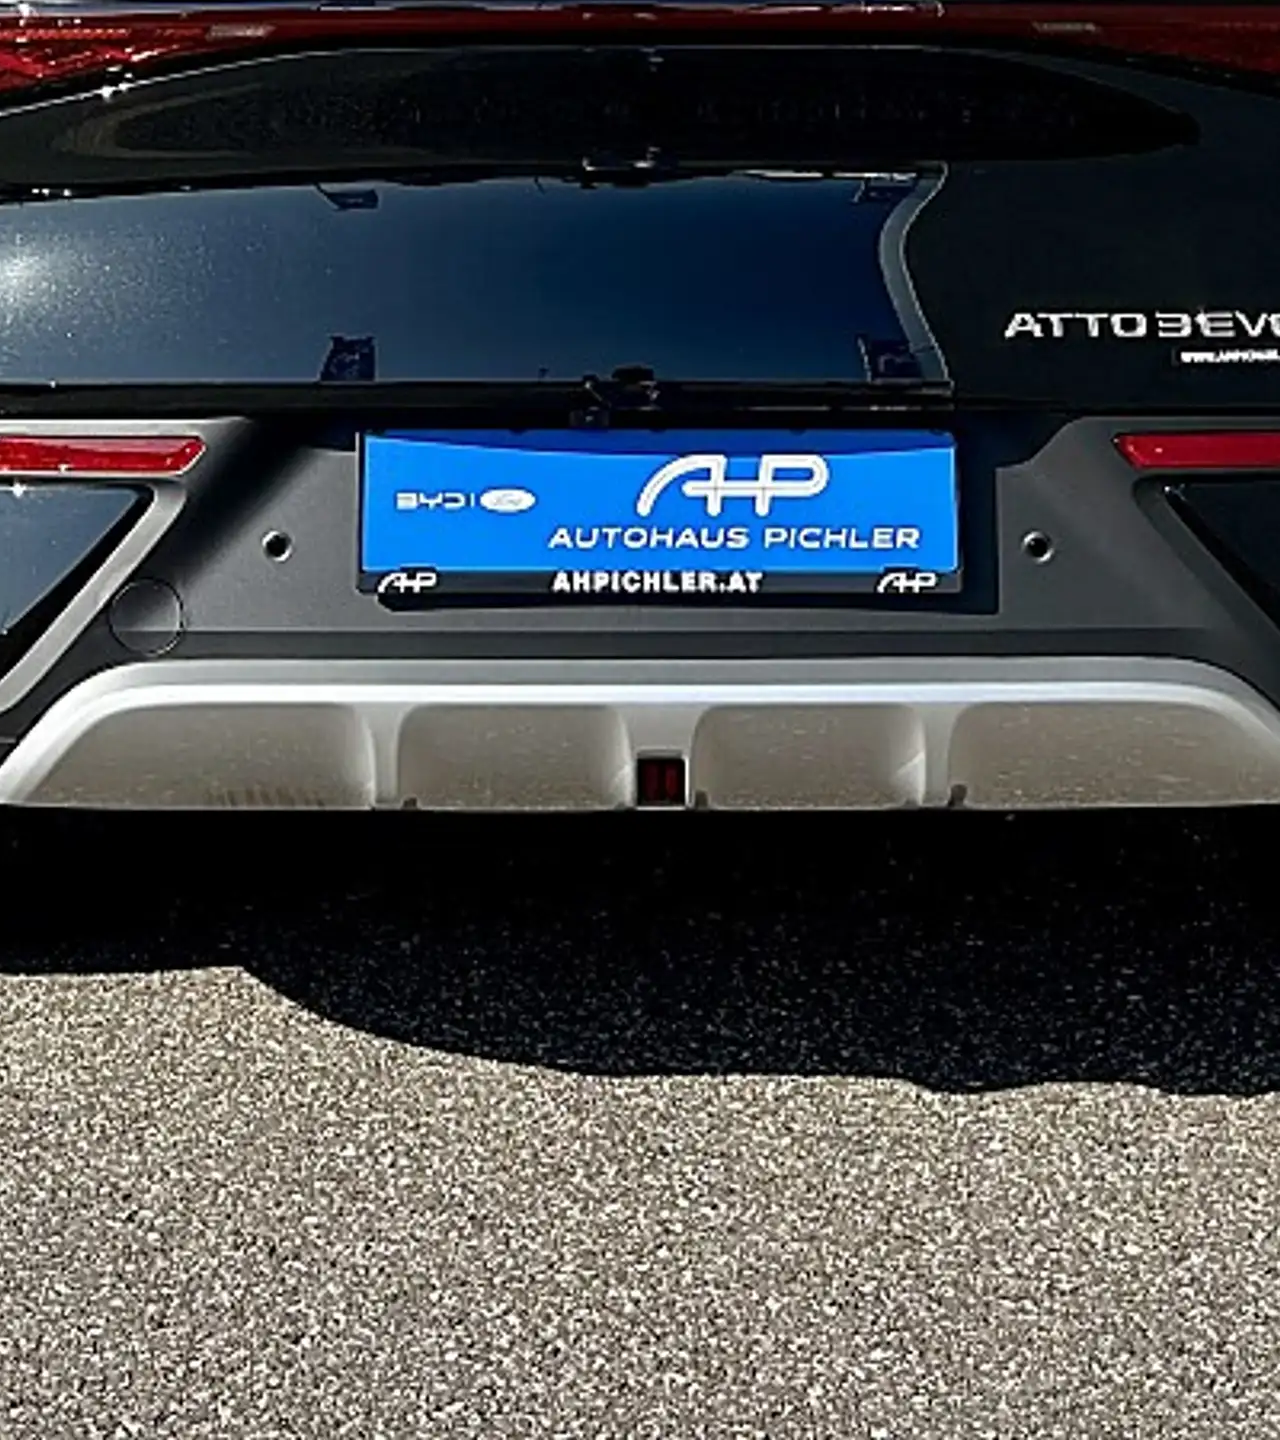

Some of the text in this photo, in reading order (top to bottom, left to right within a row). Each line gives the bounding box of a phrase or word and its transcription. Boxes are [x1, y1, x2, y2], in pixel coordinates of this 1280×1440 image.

[1004, 312, 1147, 338] ATTO
[397, 492, 466, 510] BYD
[548, 527, 921, 549] AUTOHAUS PICHLER
[551, 572, 763, 593] AHPICHLER.AT
